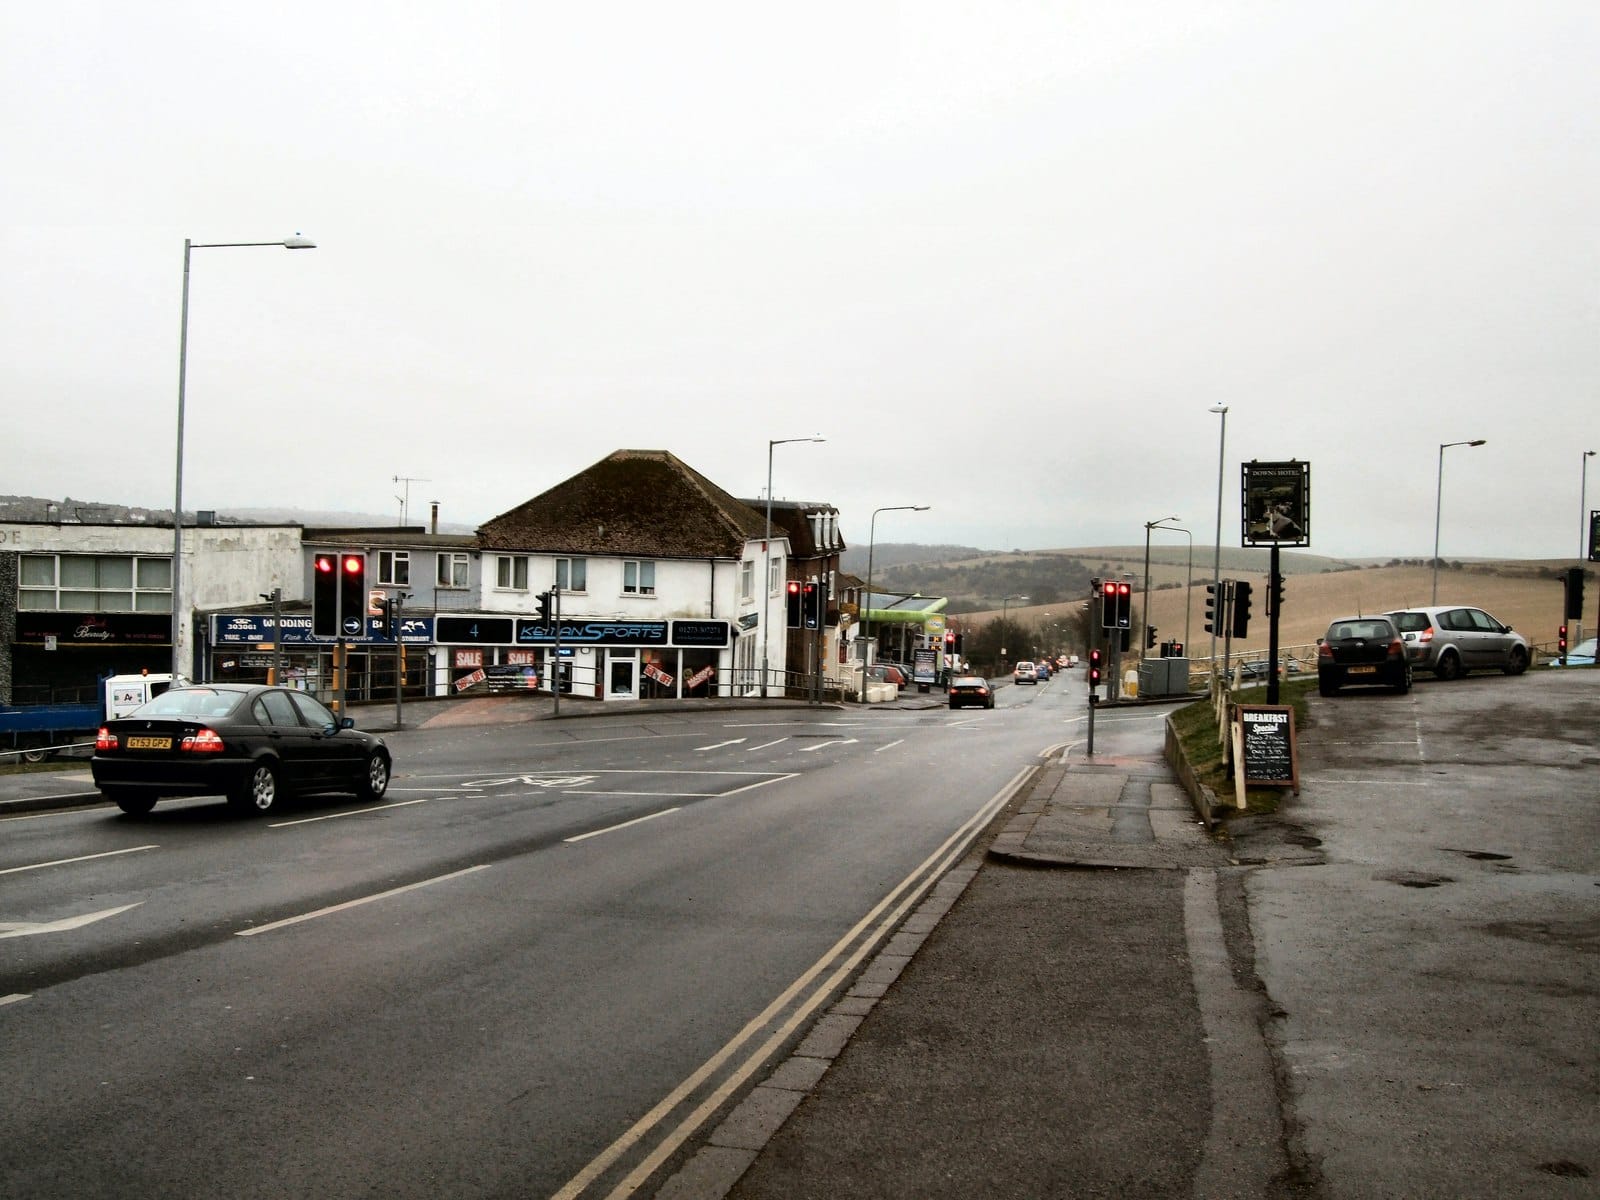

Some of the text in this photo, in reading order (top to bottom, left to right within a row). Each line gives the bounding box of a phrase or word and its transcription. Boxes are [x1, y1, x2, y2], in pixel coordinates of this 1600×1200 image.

[73, 624, 110, 640] Beauty
[469, 624, 479, 637] 4
[457, 652, 482, 666] SALE
[508, 652, 534, 665] SALE
[472, 670, 484, 681] OFF
[1243, 712, 1288, 723] BREAKFAST
[1252, 723, 1279, 735] Special
